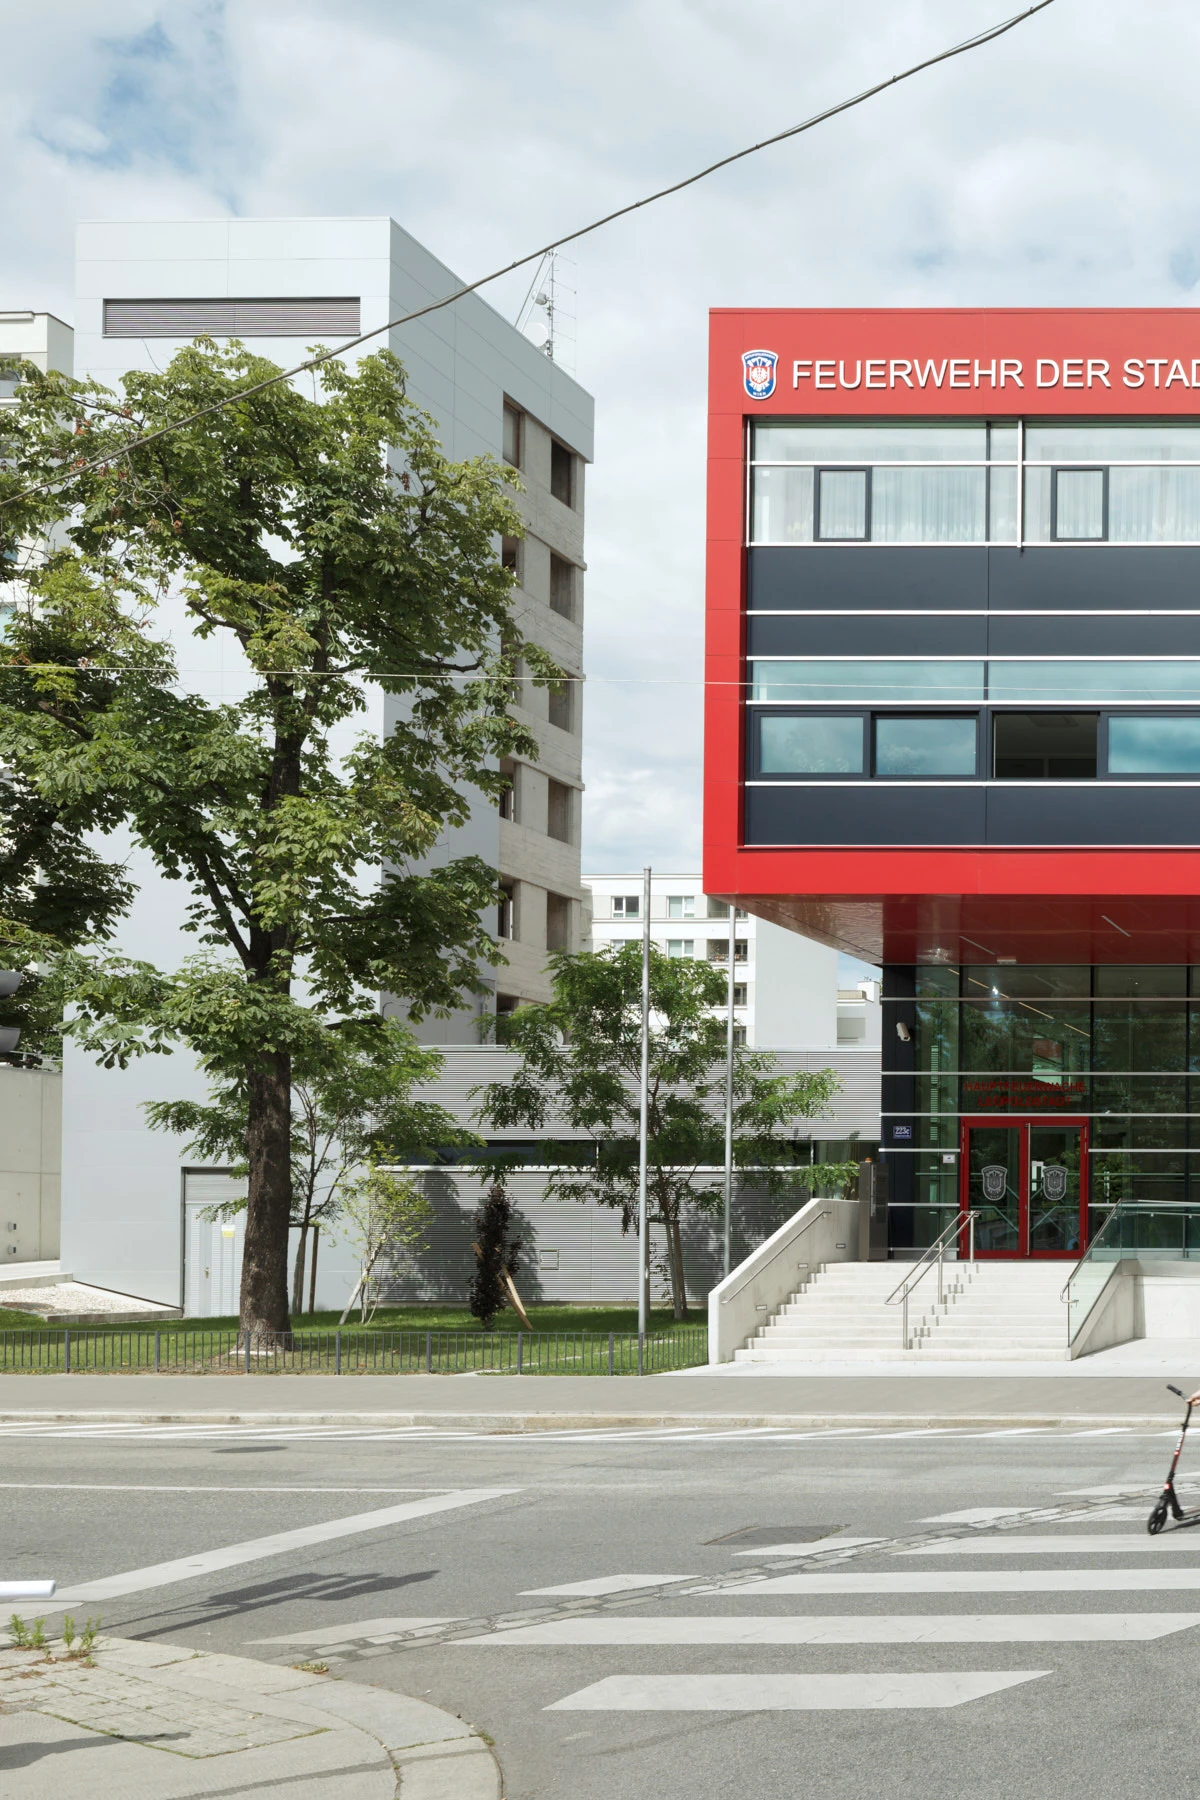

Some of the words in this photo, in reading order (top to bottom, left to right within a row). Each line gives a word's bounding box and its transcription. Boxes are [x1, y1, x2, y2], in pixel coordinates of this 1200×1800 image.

[793, 359, 1024, 388] FEUERWEHR
[1036, 359, 1111, 388] DER
[964, 1081, 1086, 1093] HAUPTFEUERWACHE
[977, 1095, 1072, 1107] LEOPOLDSTADT
